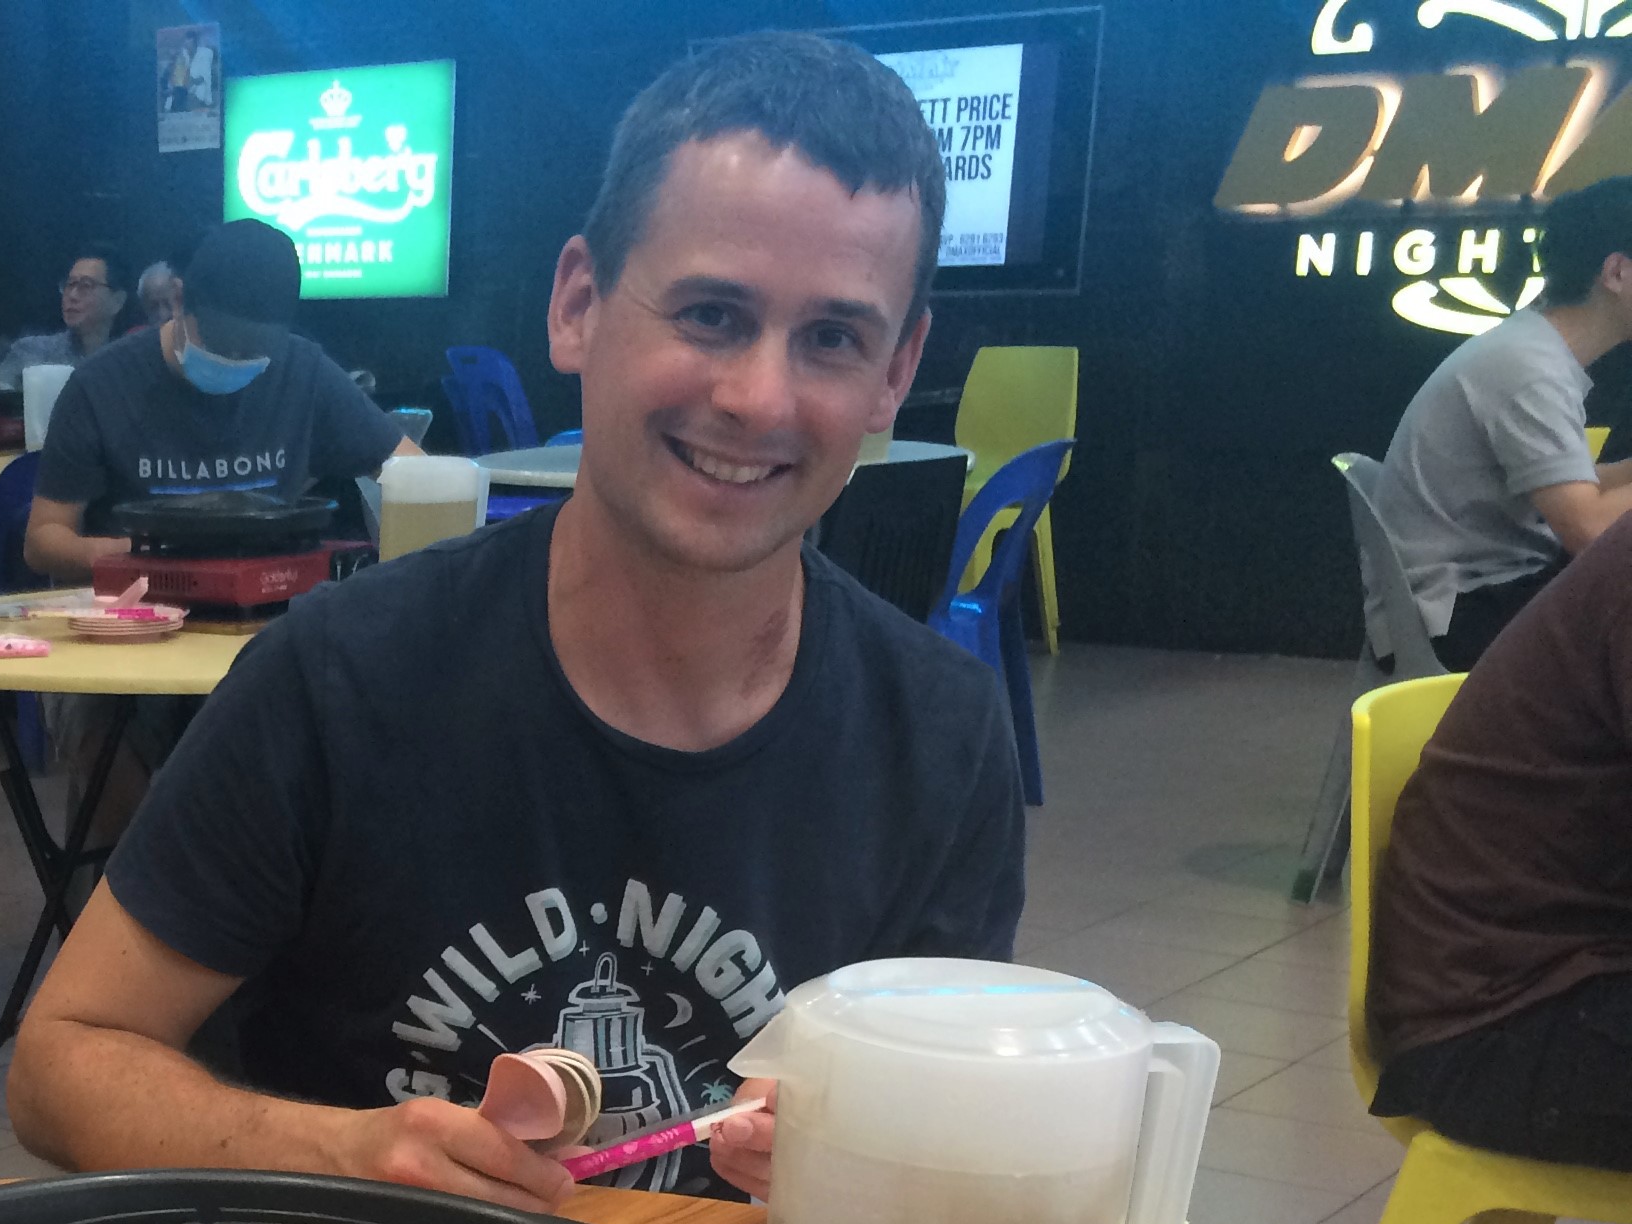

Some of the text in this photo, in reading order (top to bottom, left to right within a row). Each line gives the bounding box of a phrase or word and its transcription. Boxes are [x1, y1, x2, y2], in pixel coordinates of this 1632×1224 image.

[956, 92, 1013, 124] PRICE
[960, 123, 1002, 152] 7PM
[237, 125, 438, 229] Carlsberg
[138, 449, 286, 480] BILLABONG
[391, 887, 578, 1053] WILD
